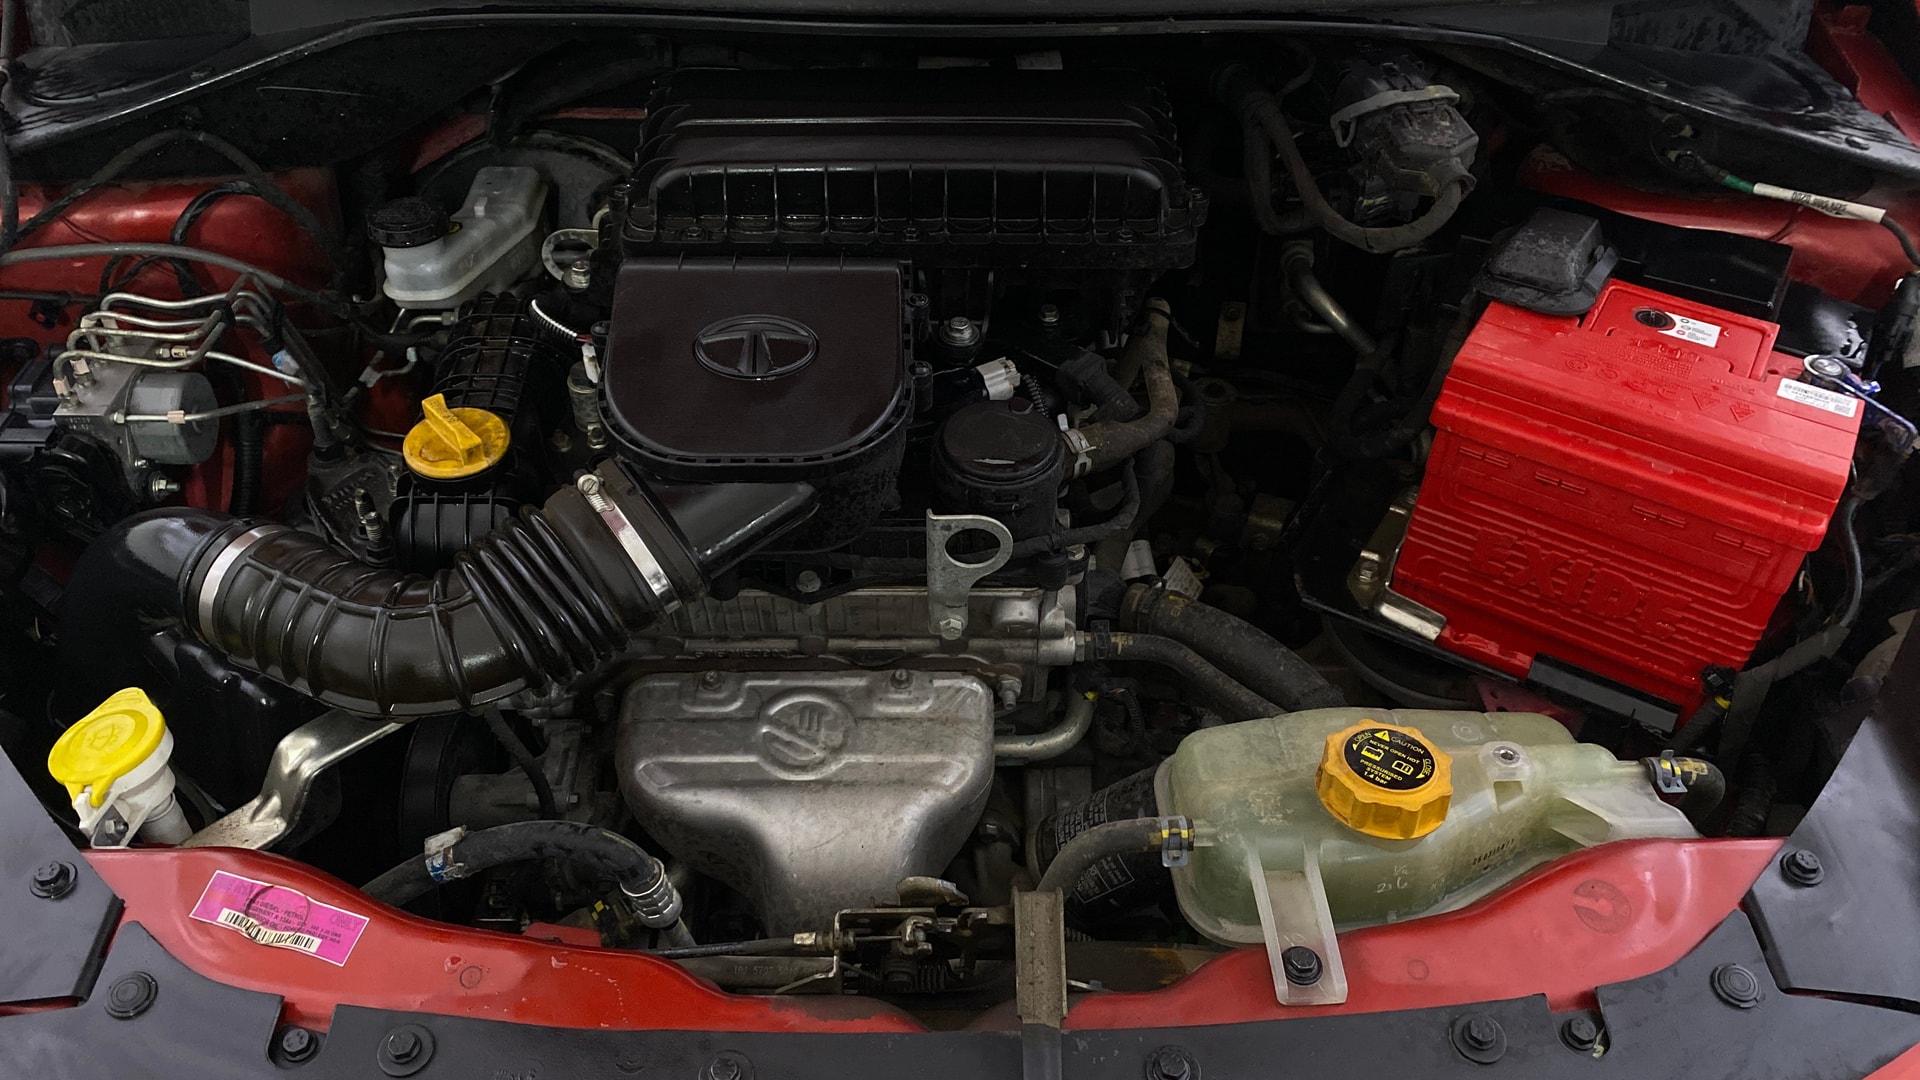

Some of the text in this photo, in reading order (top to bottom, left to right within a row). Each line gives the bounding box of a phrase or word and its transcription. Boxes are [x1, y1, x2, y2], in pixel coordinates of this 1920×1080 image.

[1470, 527, 1692, 640] EXIDE
[1354, 731, 1371, 743] OPEN
[1391, 736, 1425, 755] CAUTION
[1369, 739, 1420, 765] NEVER OPEN HOT
[1360, 759, 1403, 781] PRESSURISED
[1366, 767, 1392, 781] SYSTEM
[1423, 758, 1432, 776] CLOSE
[1364, 771, 1388, 785] 1.4 bar
[284, 908, 305, 921] PETROL
